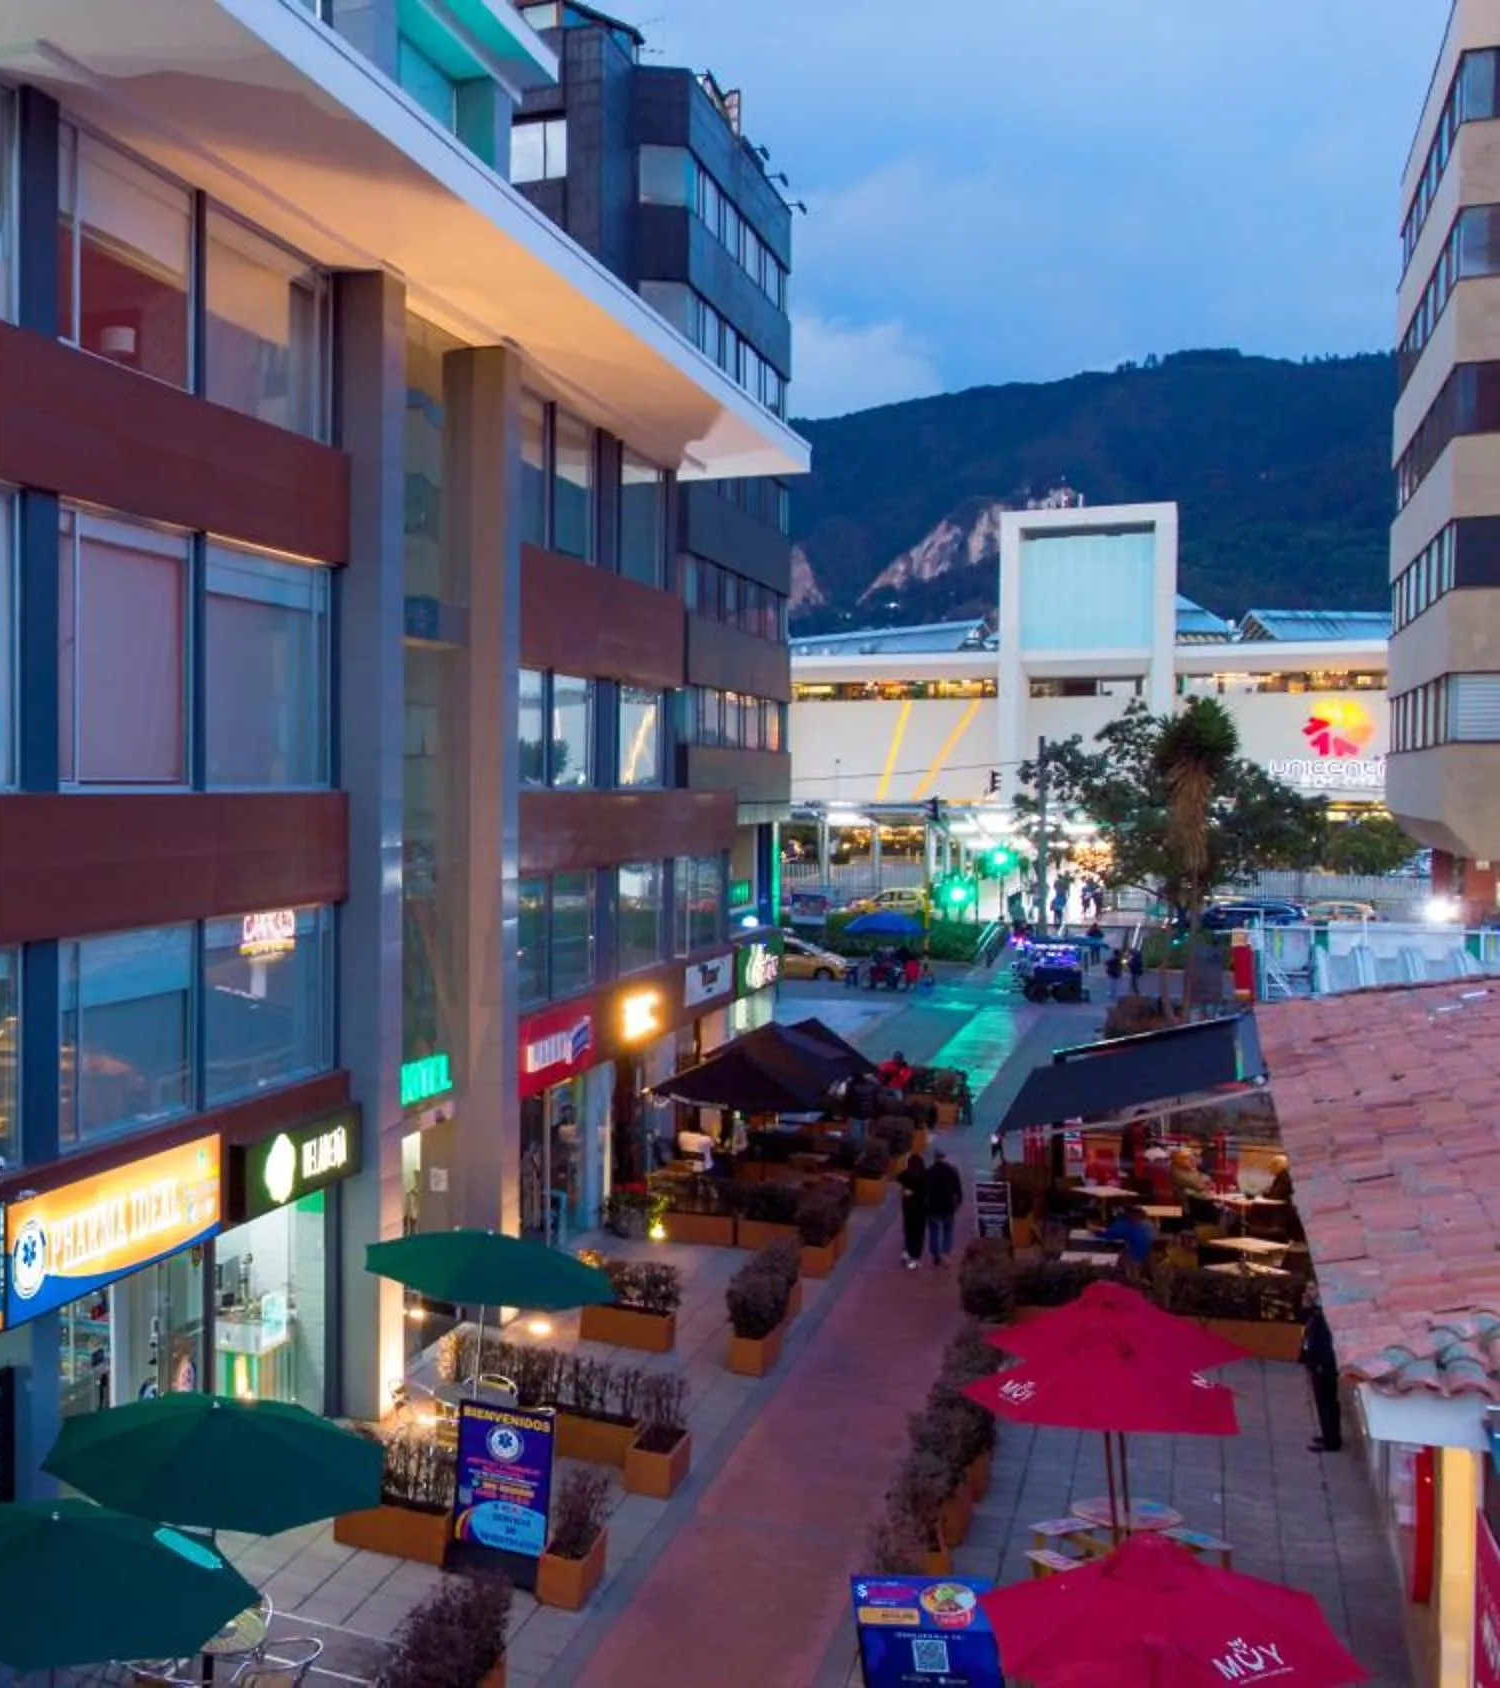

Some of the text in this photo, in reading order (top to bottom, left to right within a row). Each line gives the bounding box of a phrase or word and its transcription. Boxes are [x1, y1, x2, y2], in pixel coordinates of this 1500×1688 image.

[48, 1178, 182, 1274] PHARMA IDEAL
[463, 1405, 551, 1433] BIENVENIDOS
